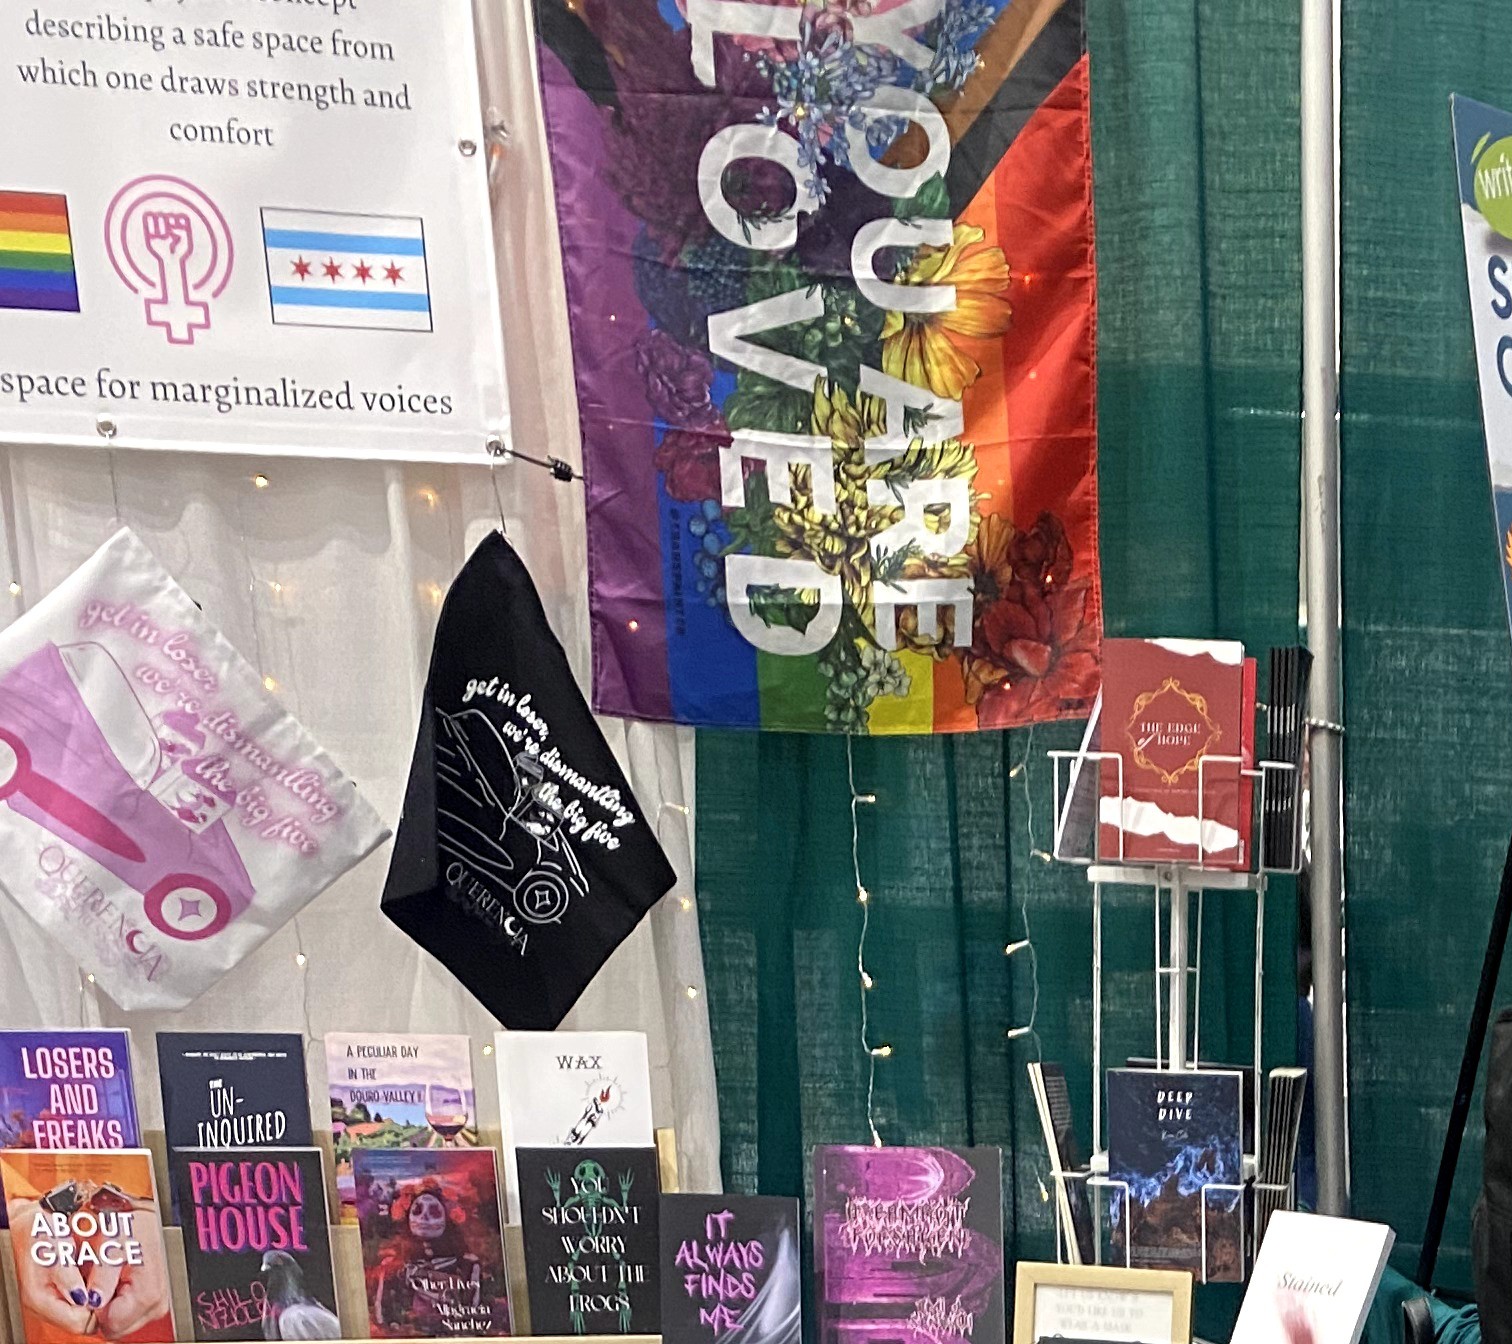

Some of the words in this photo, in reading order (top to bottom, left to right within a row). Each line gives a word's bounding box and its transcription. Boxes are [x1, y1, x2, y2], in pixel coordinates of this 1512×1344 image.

[25, 10, 165, 51] describing
[173, 28, 186, 46] a
[194, 22, 245, 49] safe
[252, 32, 324, 63] space
[331, 32, 394, 61] from
[16, 59, 98, 89] which
[107, 70, 153, 92] one
[161, 67, 239, 97] draws
[247, 75, 354, 110] strength
[363, 82, 412, 111] and
[169, 117, 274, 146] comfort
[687, 0, 843, 656] LOVED
[0, 373, 86, 405] space
[96, 367, 140, 400] for
[151, 377, 354, 413] marginalized
[364, 386, 453, 416] voices
[859, 362, 975, 651] ARE
[79, 600, 130, 631] get
[129, 615, 159, 644] in
[462, 677, 498, 702] get
[497, 683, 517, 707] in
[202, 710, 340, 824] dismantling
[503, 721, 540, 755] we're
[540, 747, 635, 827] dismantling
[196, 754, 232, 793] the
[236, 785, 270, 826] big
[261, 816, 320, 853] five
[539, 782, 563, 810] the
[563, 800, 589, 835] big
[581, 822, 621, 850] five
[21, 1047, 115, 1080] LOSERS
[347, 1045, 353, 1058] A
[357, 1045, 397, 1058] PECULIAR
[401, 1046, 418, 1058] DAY
[556, 1055, 602, 1070] WAX
[348, 1067, 357, 1080] IN
[361, 1068, 376, 1080] THE
[50, 1083, 99, 1115] AND
[209, 1086, 244, 1117] UN-
[383, 1090, 415, 1104] VALLEY
[1157, 1089, 1194, 1104] DEEP
[1158, 1107, 1192, 1121] DIVE
[33, 1119, 124, 1149] FREAKS
[197, 1111, 286, 1149] INQUIRED
[188, 1160, 301, 1205] PIGEON
[571, 1176, 608, 1194] YOU
[31, 1212, 134, 1238] ABOUT
[194, 1206, 308, 1252] HOUSE
[541, 1206, 641, 1225] SHOULDN'T
[705, 1212, 734, 1239] IT
[30, 1240, 144, 1267] GRACE
[561, 1236, 627, 1254] WORRY
[674, 1240, 765, 1270] ALWAYS
[545, 1265, 607, 1283] ABOUT
[618, 1264, 649, 1283] THE
[683, 1271, 757, 1300] FINDS
[1277, 1271, 1344, 1297] Stained
[569, 1294, 629, 1313] FROGS
[700, 1302, 745, 1336] ME
